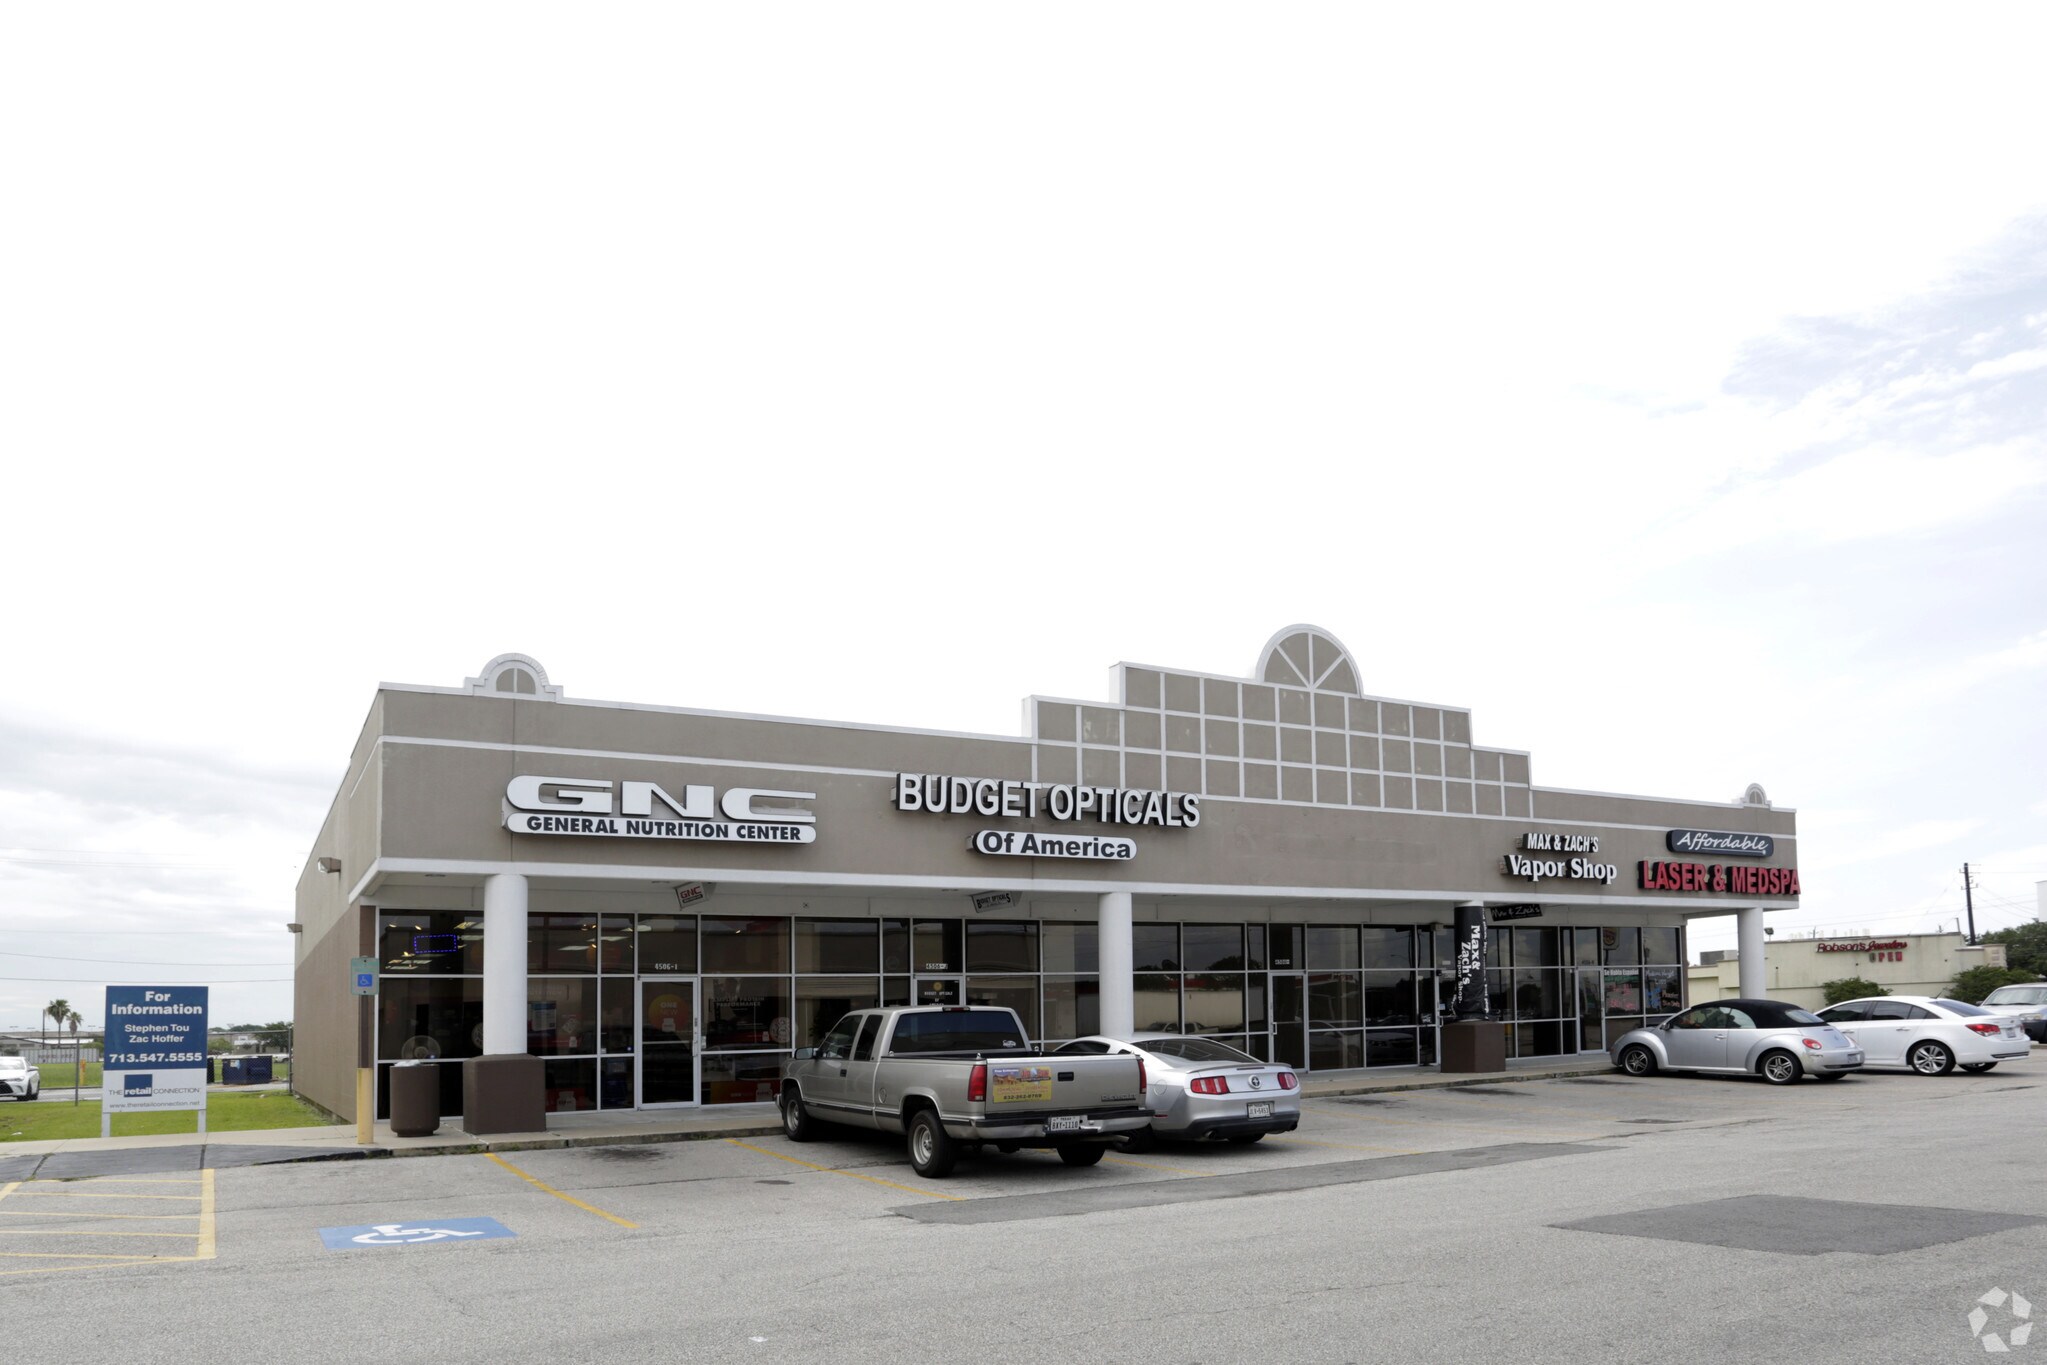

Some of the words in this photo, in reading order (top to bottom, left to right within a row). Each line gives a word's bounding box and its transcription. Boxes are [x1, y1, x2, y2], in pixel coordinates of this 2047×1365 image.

[506, 775, 817, 823] GNC
[897, 773, 1042, 818] BUDGET
[1049, 784, 1200, 827] OPTICALS
[527, 816, 618, 834] GENERAL
[626, 820, 729, 838] NUTRITION
[736, 824, 801, 841] CENTER
[983, 831, 1014, 853] Of
[1021, 834, 1131, 859] America
[1527, 833, 1551, 850] MAX
[1554, 834, 1561, 850] &
[1564, 835, 1599, 852] ZACH'S
[1677, 832, 1769, 850] Affordable
[1509, 854, 1566, 882] Vapor
[1571, 858, 1617, 885] Shop
[1642, 860, 1707, 891] LASER
[1713, 864, 1726, 891] &
[1732, 866, 1801, 895] MEDSPA
[680, 885, 702, 899] GNC
[1817, 942, 1866, 954] Robson's
[1461, 941, 1473, 985] Zach's
[1869, 951, 1903, 963] OPEN
[145, 991, 171, 1002] For
[111, 1004, 202, 1015] Information
[124, 1024, 169, 1034] Stephen
[170, 1024, 190, 1032] Tou
[129, 1035, 149, 1043] Zac
[151, 1035, 184, 1043] Hoffer
[109, 1053, 202, 1063] 713.547.5555
[124, 1087, 152, 1096] retail
[153, 1087, 200, 1095] CONNECTION
[109, 1100, 200, 1109] www.theretailconnection.net
